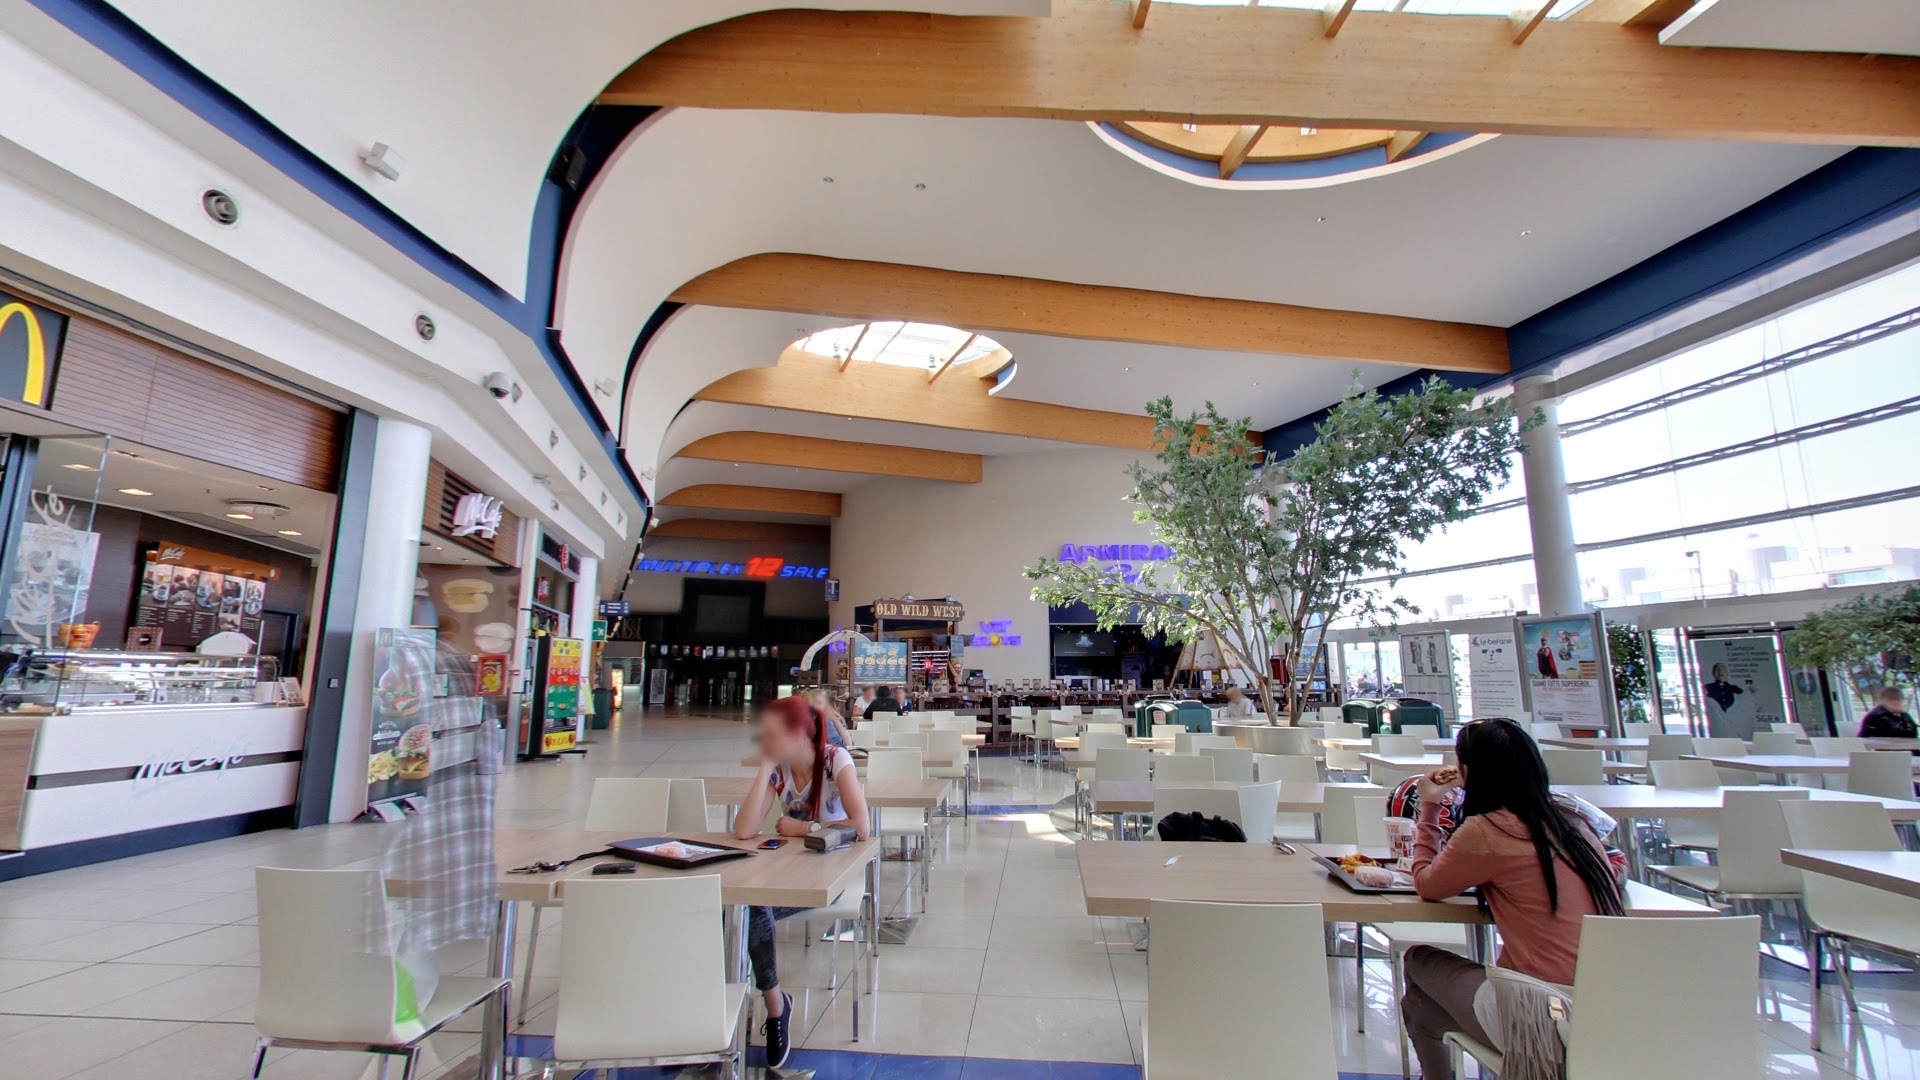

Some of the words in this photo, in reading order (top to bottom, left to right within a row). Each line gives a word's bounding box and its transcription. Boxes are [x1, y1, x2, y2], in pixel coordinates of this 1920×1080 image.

[1060, 544, 1188, 564] ADMIRA
[637, 558, 744, 575] MULTIPLEX
[746, 557, 784, 577] 12
[780, 565, 829, 579] SALE
[877, 603, 897, 616] OLD
[901, 604, 929, 617] WILD
[932, 605, 962, 618] WEST
